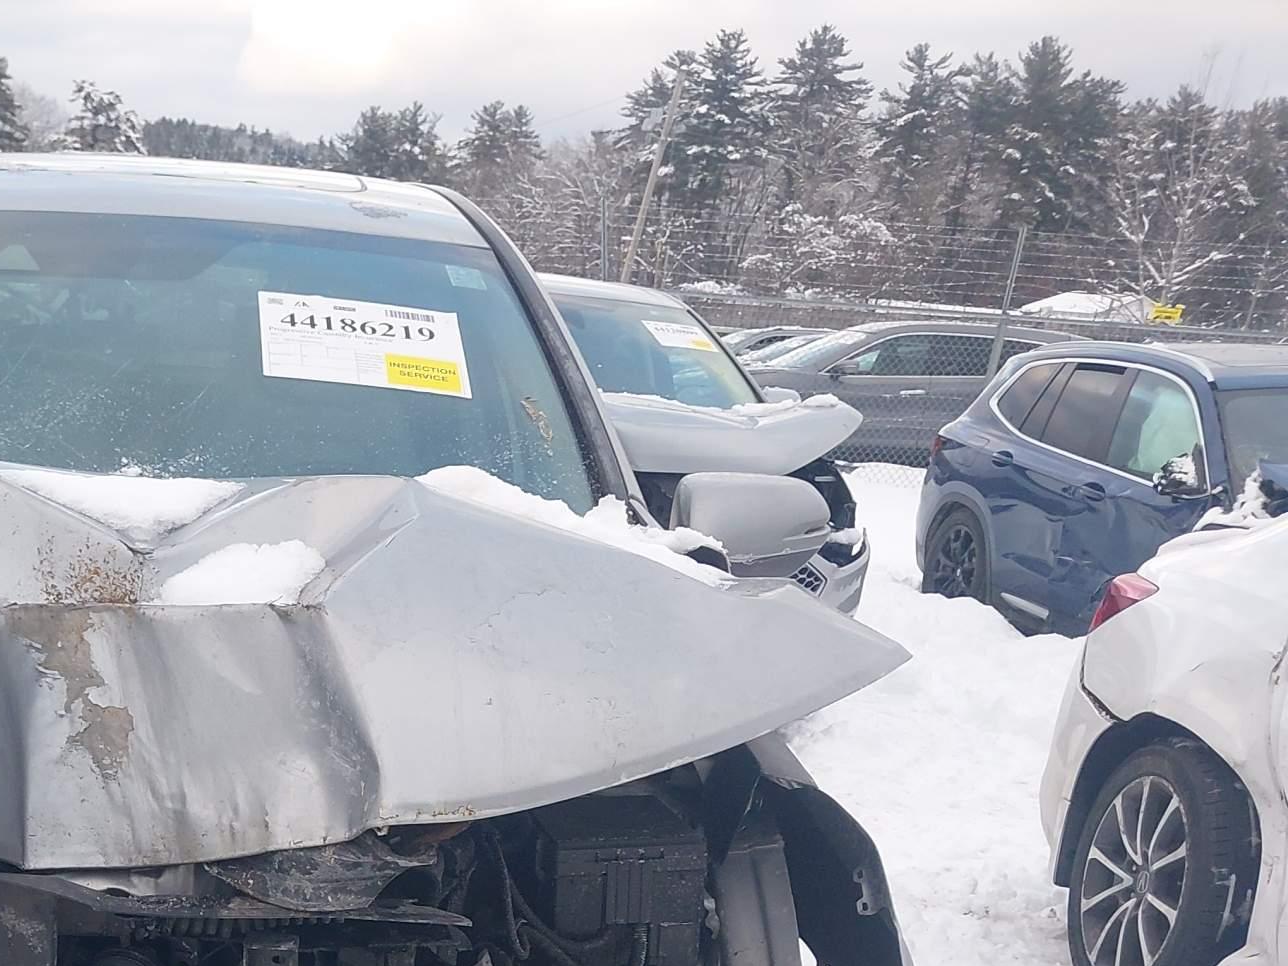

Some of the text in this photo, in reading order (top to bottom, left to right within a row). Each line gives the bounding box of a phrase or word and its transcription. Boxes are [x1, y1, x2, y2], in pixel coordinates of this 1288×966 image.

[280, 313, 435, 341] 44186219
[389, 361, 456, 375] INSPECTION
[399, 370, 448, 382] SERVICE
